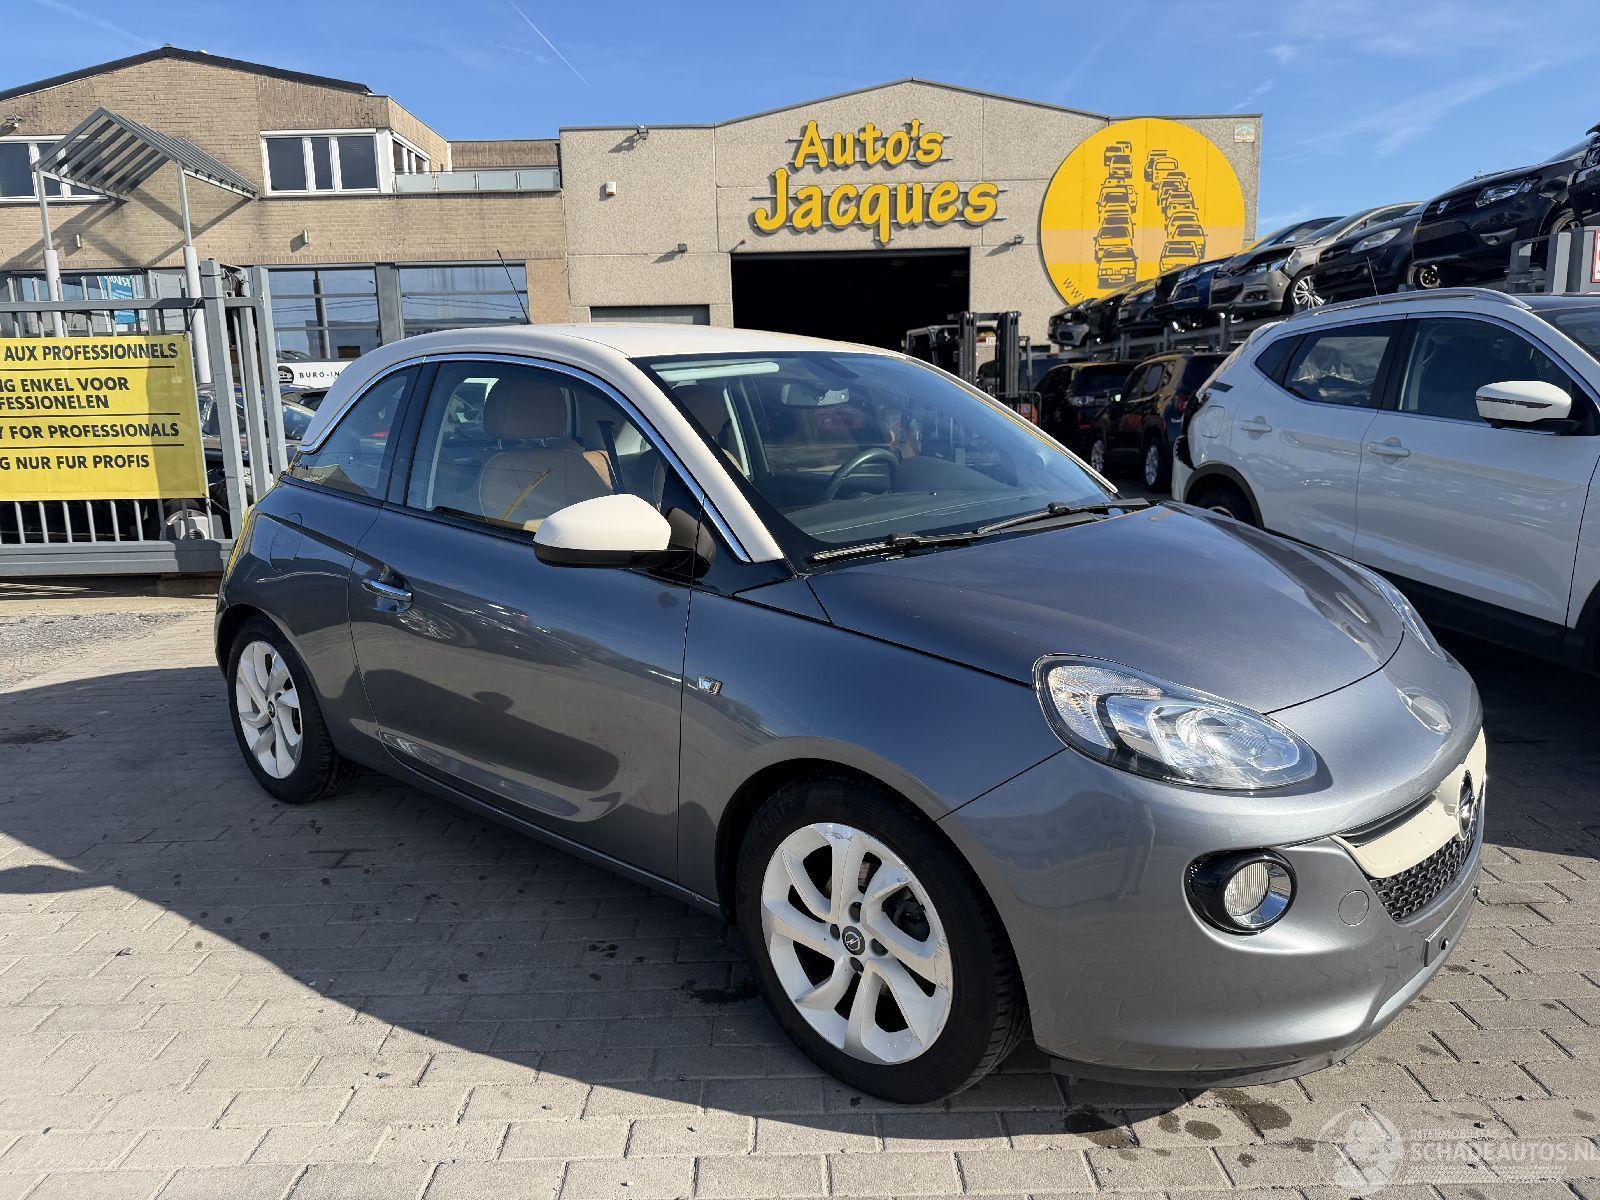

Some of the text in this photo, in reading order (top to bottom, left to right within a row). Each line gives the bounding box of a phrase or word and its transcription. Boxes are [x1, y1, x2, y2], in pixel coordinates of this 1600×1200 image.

[794, 118, 944, 168] Auto's
[754, 167, 999, 244] Jacques
[4, 343, 178, 361] AUX PROFESSIONNELS
[0, 376, 130, 393] G ENKEL VOOR
[9, 424, 44, 439] FOR
[48, 422, 180, 438] PROFESSIONALS
[16, 455, 52, 470] NUR
[56, 455, 88, 470] FUR
[92, 454, 150, 469] PROFIS
